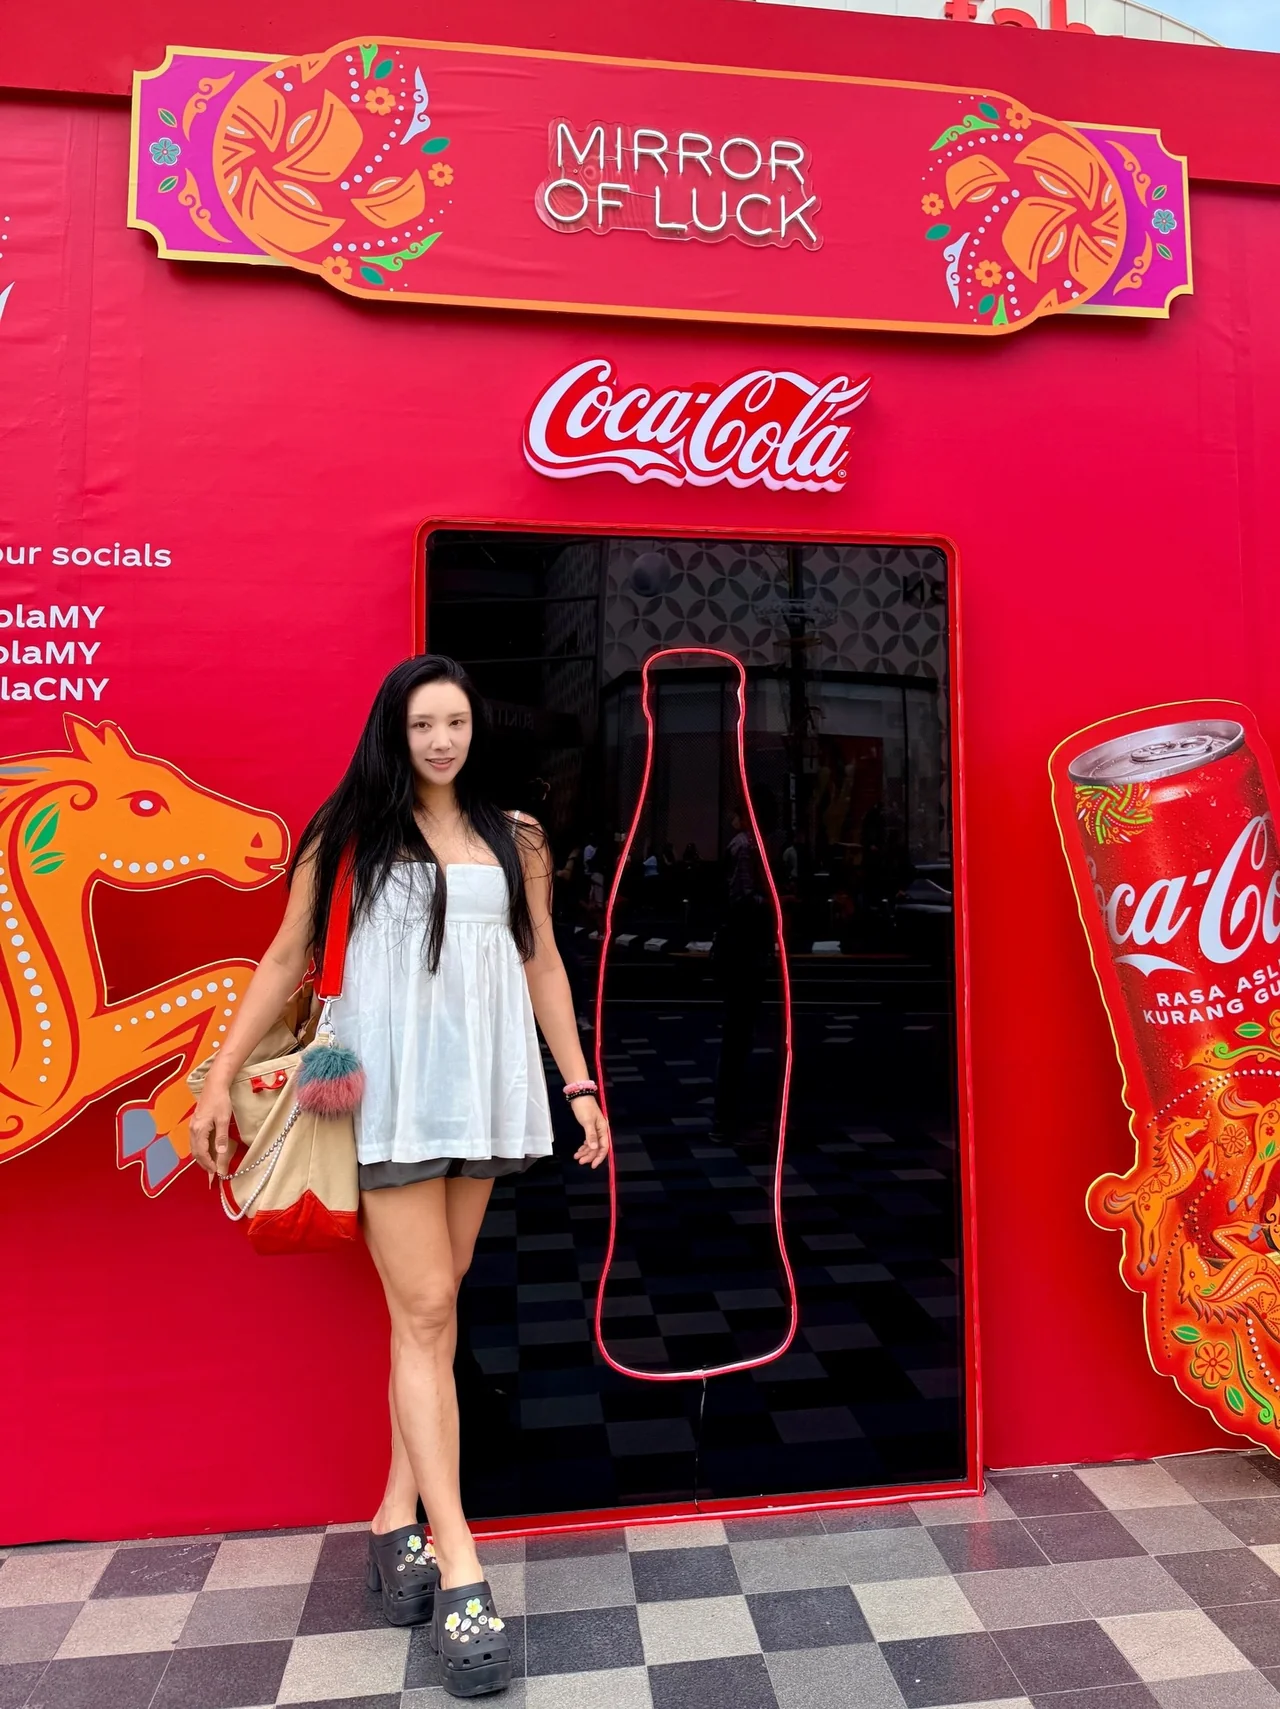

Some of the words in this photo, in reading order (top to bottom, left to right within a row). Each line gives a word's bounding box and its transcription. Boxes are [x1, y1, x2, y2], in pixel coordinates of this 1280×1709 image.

[557, 123, 804, 184] MIRROR
[544, 178, 629, 225] OF
[655, 186, 816, 242] LUCK
[528, 359, 871, 477] Coca-Cola
[0, 546, 41, 565] ur
[52, 542, 171, 567] socials
[1156, 984, 1226, 1007] RASA
[1237, 959, 1280, 993] ASL
[1143, 998, 1244, 1025] KURANG
